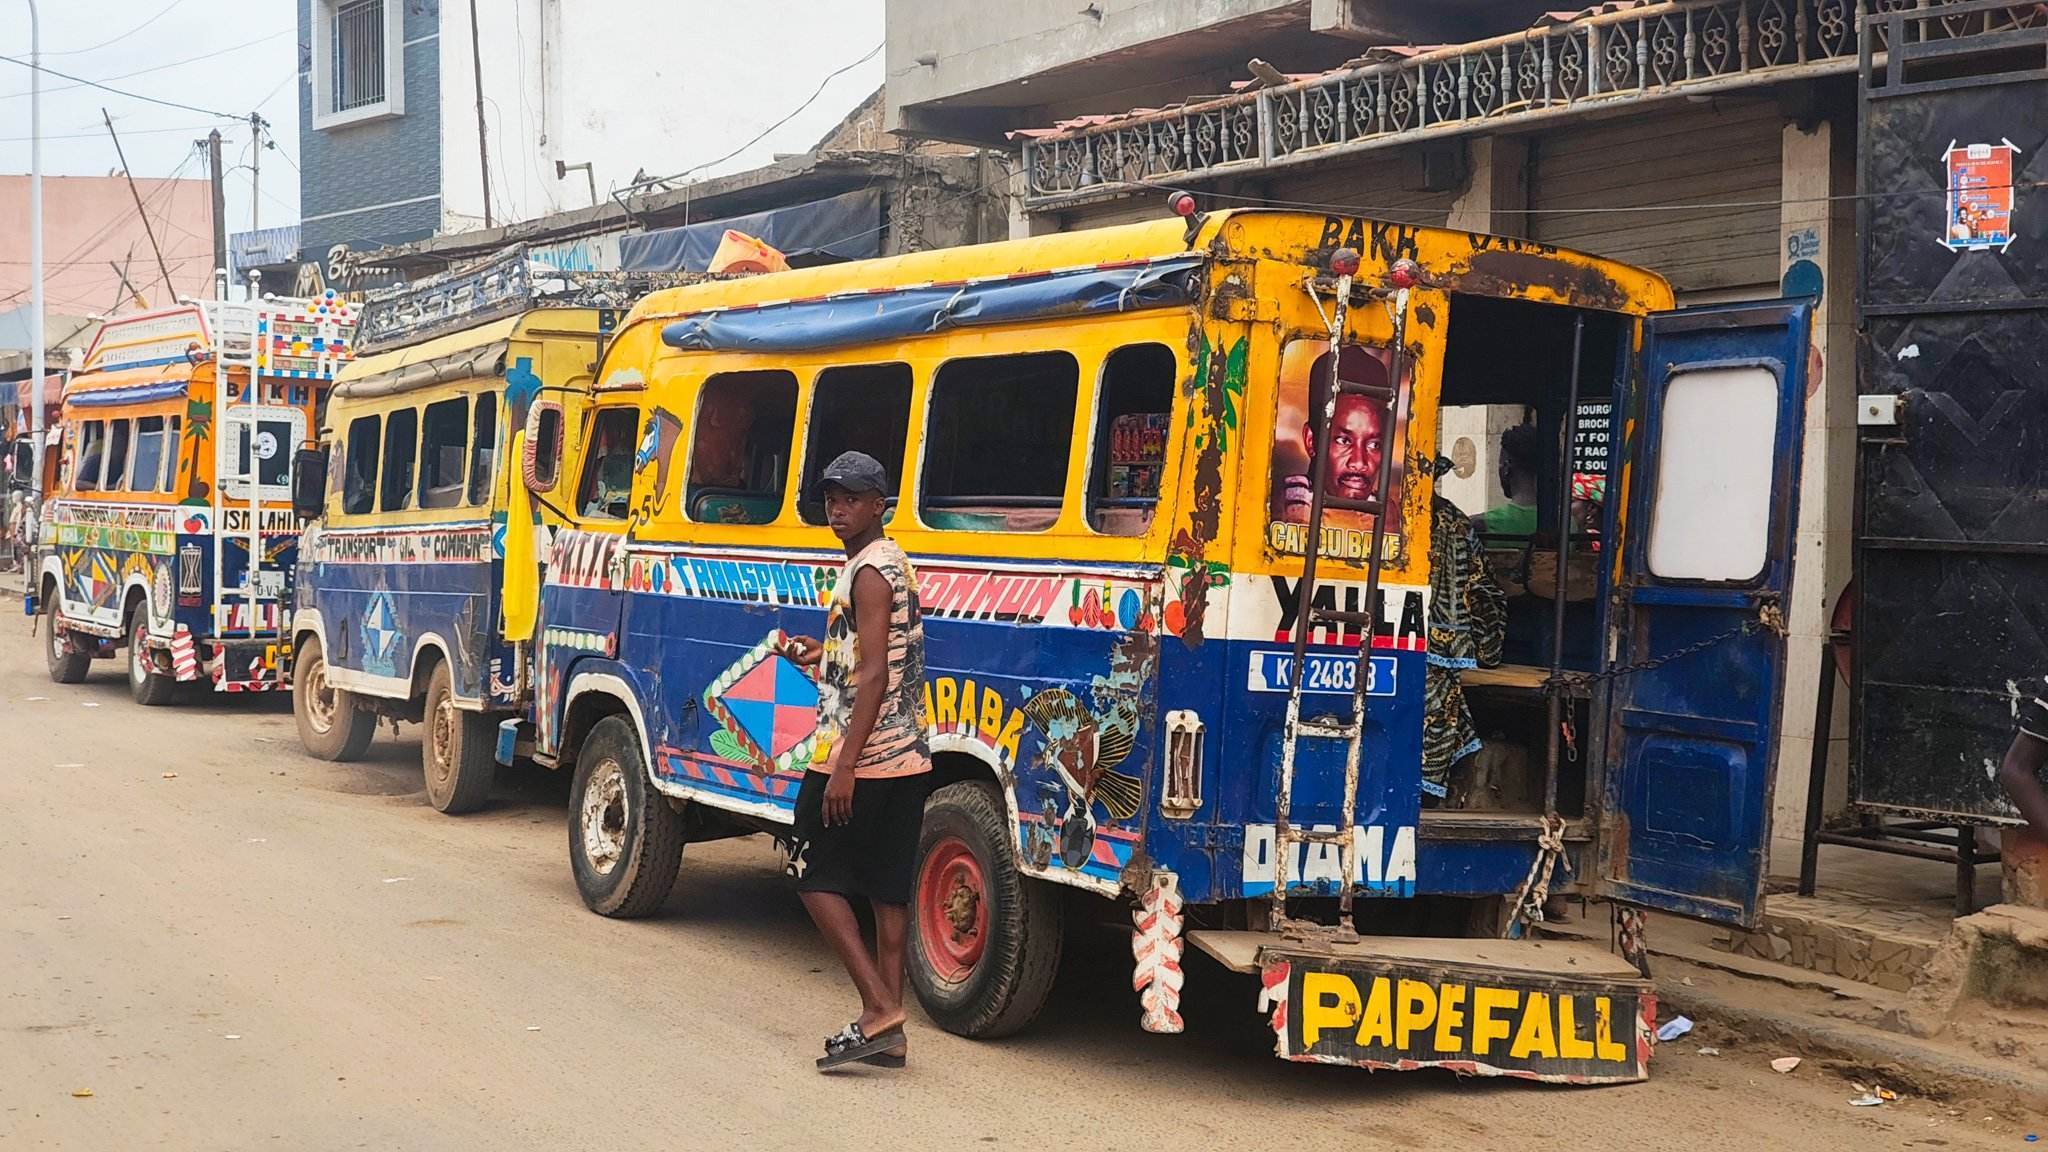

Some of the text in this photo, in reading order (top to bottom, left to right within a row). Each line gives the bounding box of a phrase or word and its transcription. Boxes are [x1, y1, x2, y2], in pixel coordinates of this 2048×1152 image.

[1318, 216, 1420, 262] BAKH
[1588, 432, 1610, 443] FO
[328, 536, 386, 562] TRANSPORT
[671, 556, 818, 606] TRANSPORT
[1270, 575, 1428, 652] YALLA
[1471, 986, 1627, 1062] FALL
